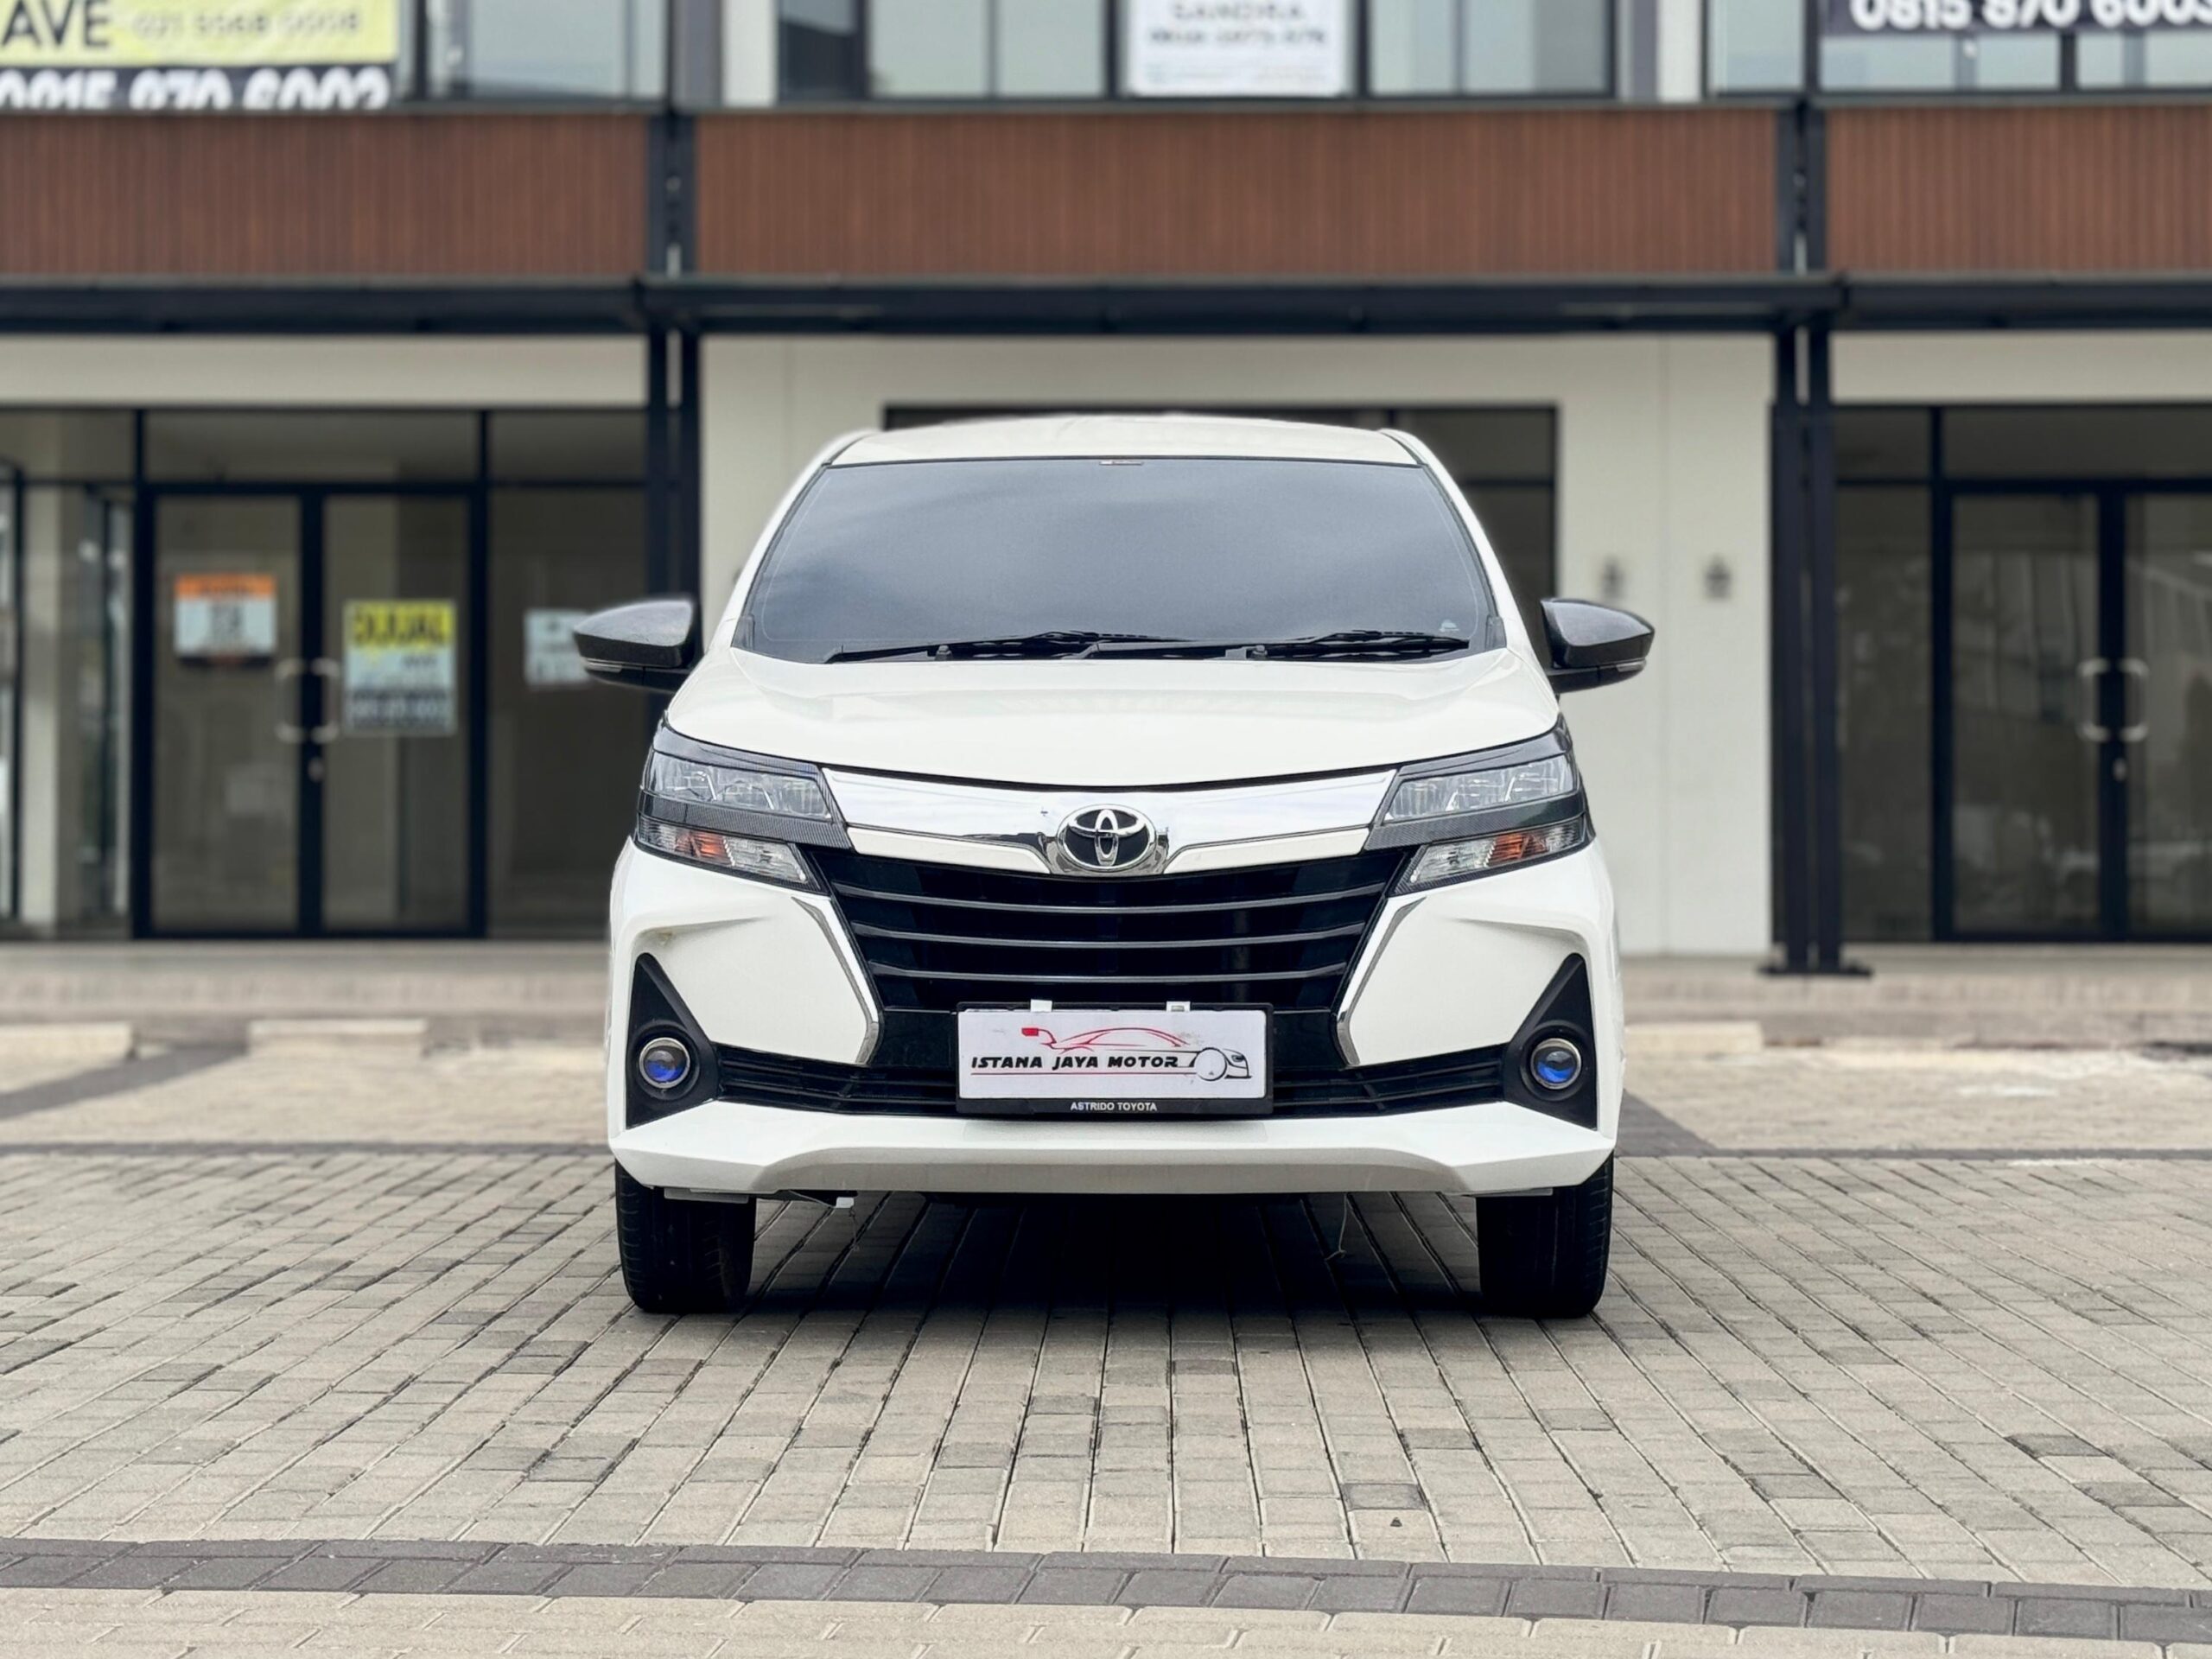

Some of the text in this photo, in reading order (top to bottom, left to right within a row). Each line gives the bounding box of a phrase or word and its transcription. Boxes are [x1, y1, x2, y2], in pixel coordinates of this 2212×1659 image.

[971, 1056, 1178, 1071] ISTANA JAYA MOTOR
[1070, 1102, 1157, 1112] ASTRIDO TOYOTA
